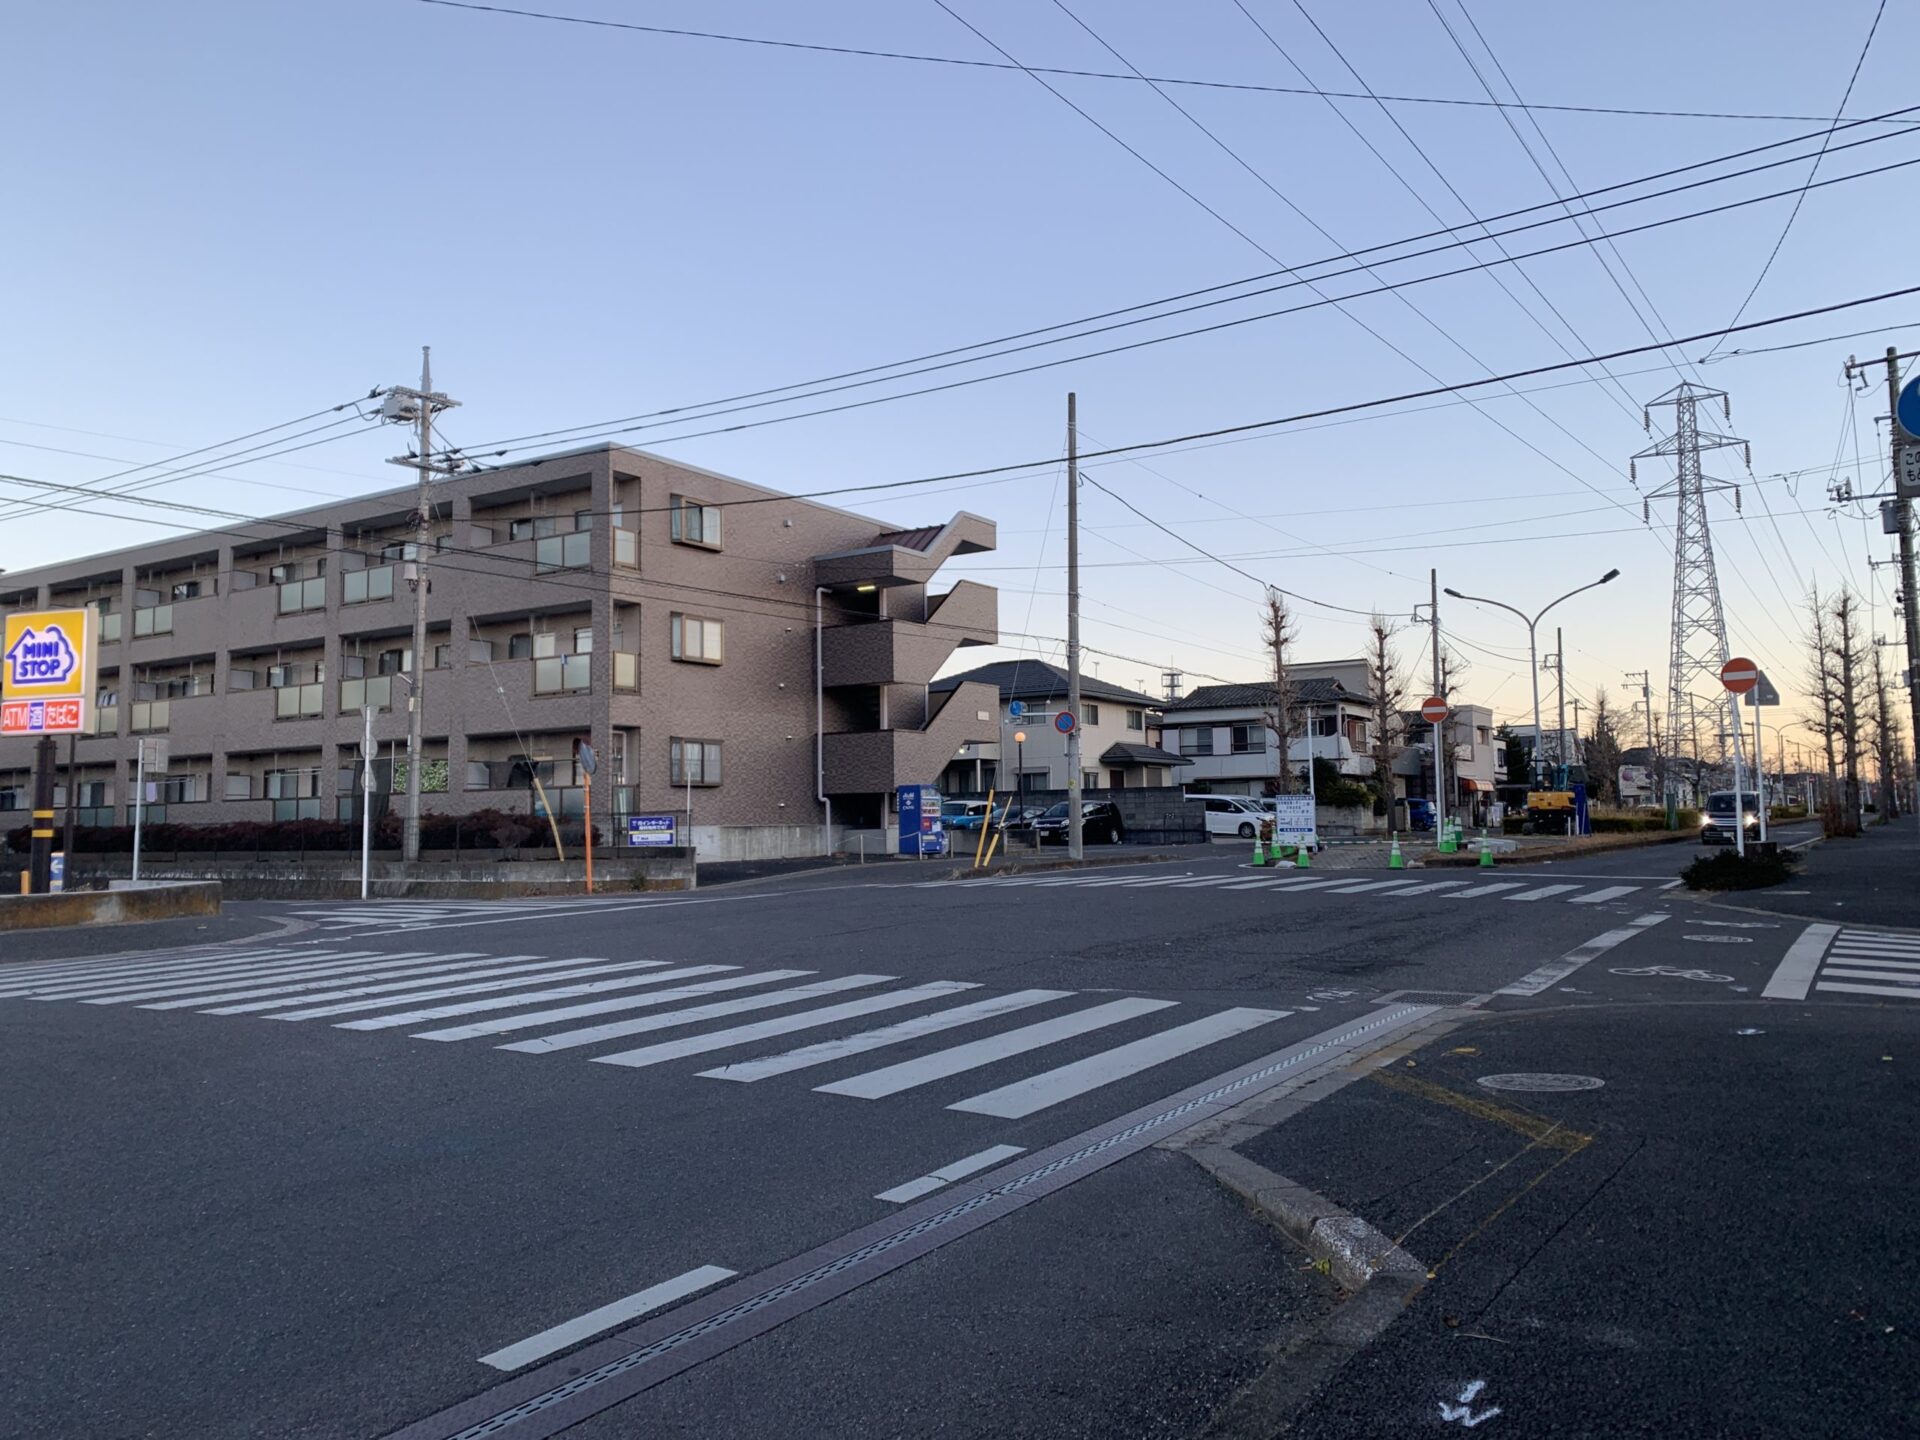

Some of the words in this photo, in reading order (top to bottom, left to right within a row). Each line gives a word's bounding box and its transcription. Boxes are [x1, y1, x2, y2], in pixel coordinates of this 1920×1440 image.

[22, 641, 60, 659] MINI
[19, 658, 61, 677] STOP
[2, 706, 27, 728] ATM
[30, 704, 43, 727] 酒
[46, 703, 78, 726] たばこ
